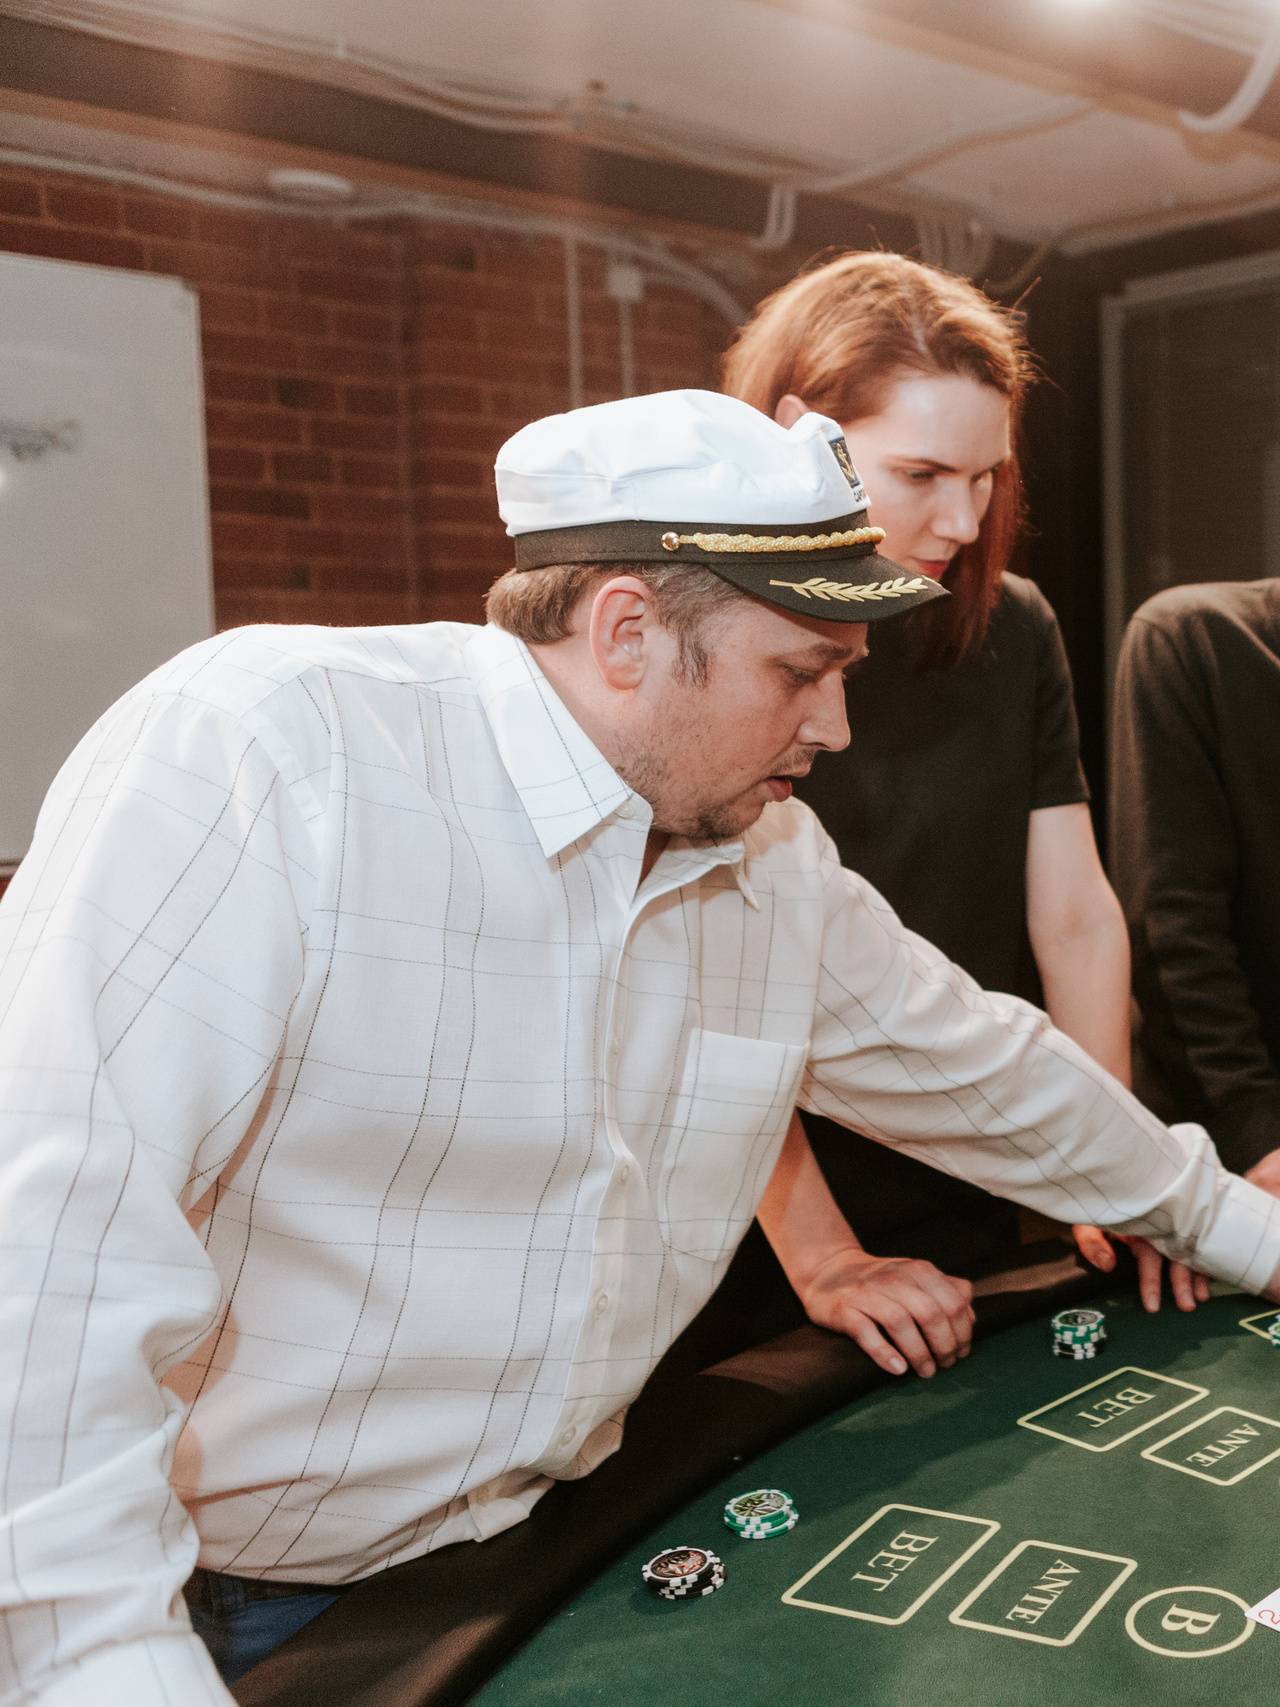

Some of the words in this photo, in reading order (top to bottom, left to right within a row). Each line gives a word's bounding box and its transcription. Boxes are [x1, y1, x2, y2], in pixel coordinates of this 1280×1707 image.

[1076, 1386, 1156, 1429] BET
[1186, 1422, 1261, 1468] ANTE
[849, 1528, 940, 1592] BET
[1004, 1557, 1082, 1625] ANTE
[1160, 1602, 1222, 1636] B
